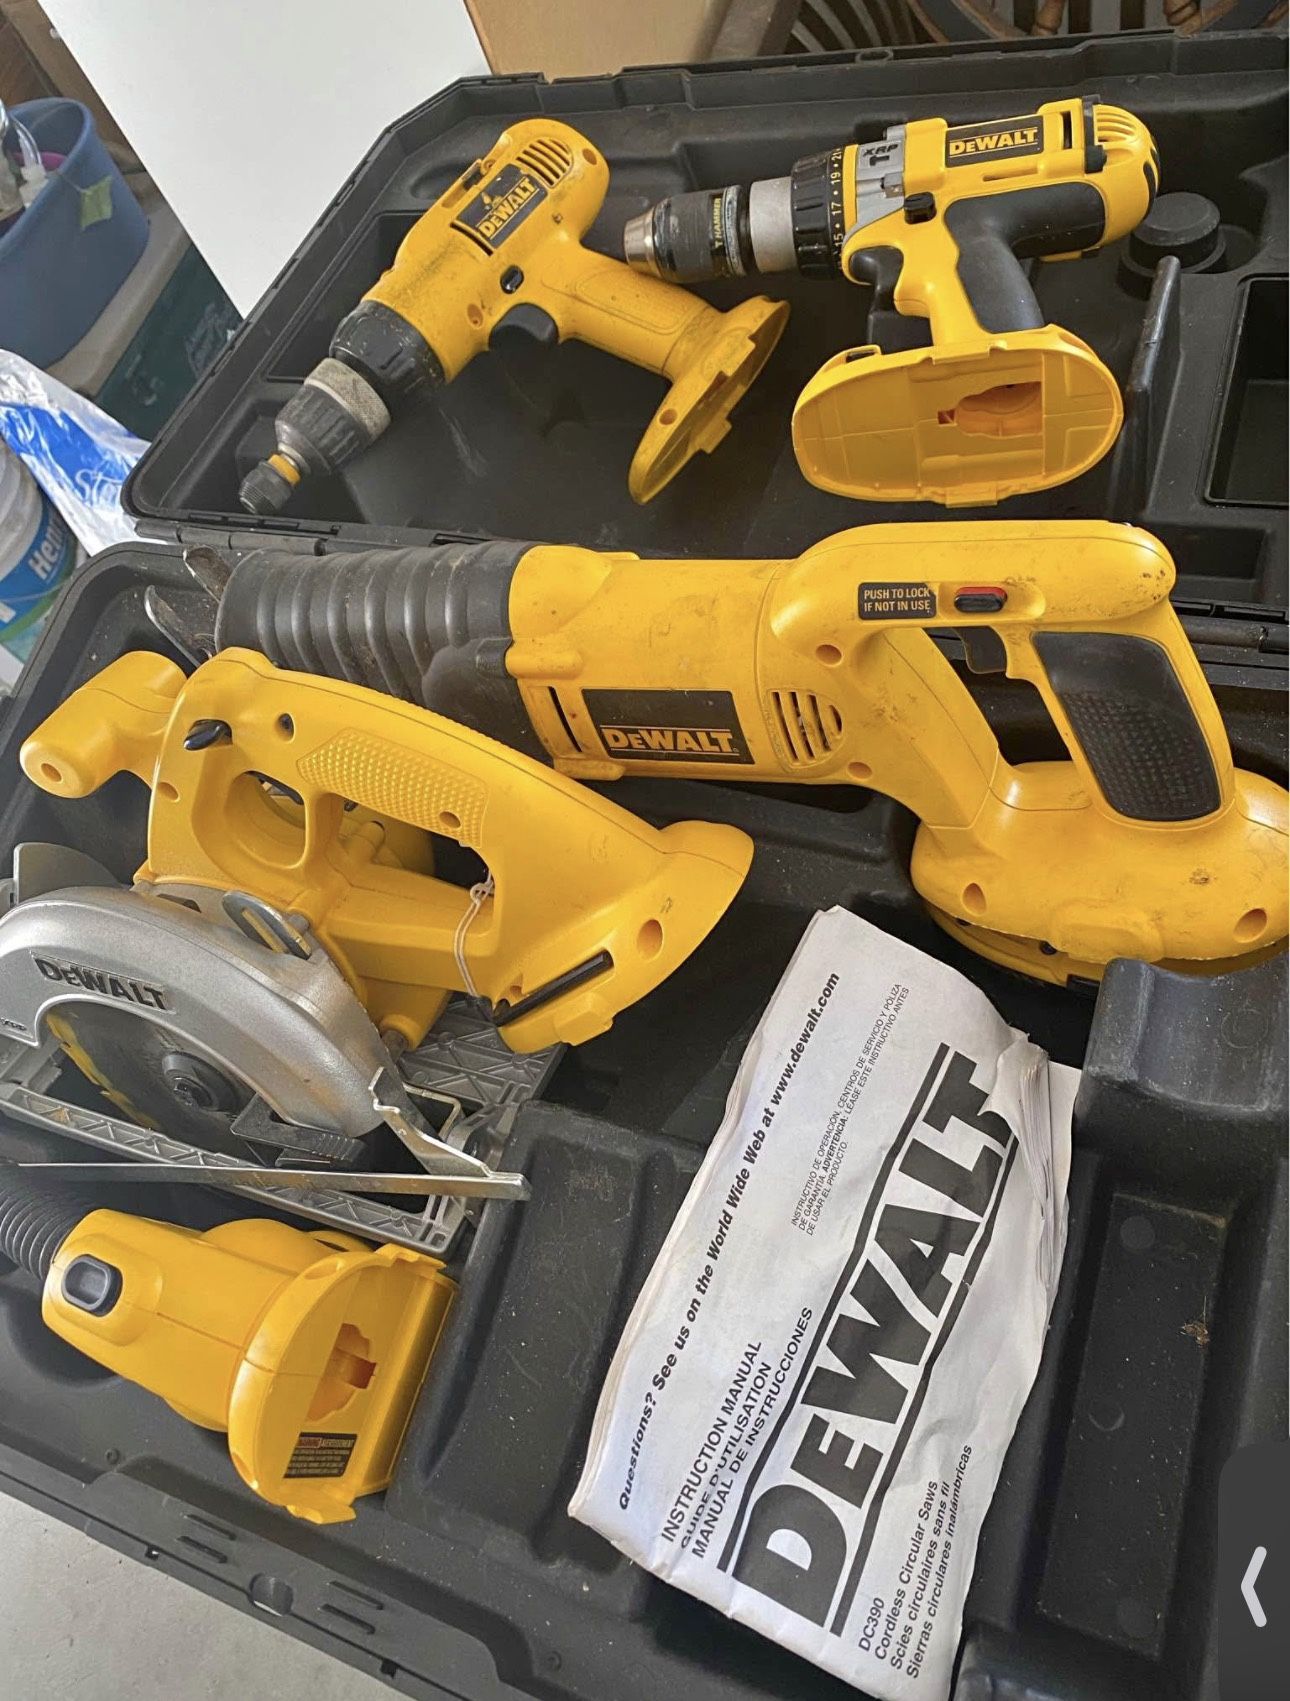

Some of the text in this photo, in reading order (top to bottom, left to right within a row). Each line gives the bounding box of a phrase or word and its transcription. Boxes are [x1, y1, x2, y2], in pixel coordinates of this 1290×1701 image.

[863, 144, 898, 156] XRP
[831, 172, 842, 185] 19
[714, 198, 723, 238] HAMMER
[831, 202, 842, 216] 17
[833, 233, 843, 246] 15
[864, 588, 930, 600] PUSH TO LOCK
[864, 600, 930, 612] IF NOT IN USE
[858, 1052, 867, 1068] DE
[862, 1018, 884, 1056] SERVICIO
[800, 1216, 808, 1231] DE
[822, 1115, 849, 1172] ADVERTENCIA:
[846, 1086, 862, 1116] LÉASE
[858, 1064, 873, 1089] ESTE
[870, 1014, 897, 1066] INSTRUCTIVO
[895, 988, 909, 1014] ANTES
[838, 1067, 861, 1108] CENTROS
[814, 1156, 822, 1170] DE
[791, 1171, 818, 1226] INSTRUCTIVO
[807, 1141, 849, 1236] DE USAR EL PRODUCTO.
[620, 972, 840, 1510] Questions? See us on the World Wide Web at www.dewalt.com
[661, 1340, 762, 1542] INSTRUCTION MANUAL
[680, 1362, 772, 1550] GUIDE D'UTILISATION
[692, 1307, 813, 1558] MANUAL DE INSTRUCCIONES
[874, 1480, 938, 1660] Cordless Circular Saws
[890, 1482, 950, 1670] Scies circulaires sans fil
[907, 1444, 972, 1678] Sierras circulares inalámbricas
[858, 1597, 885, 1652] DC390
